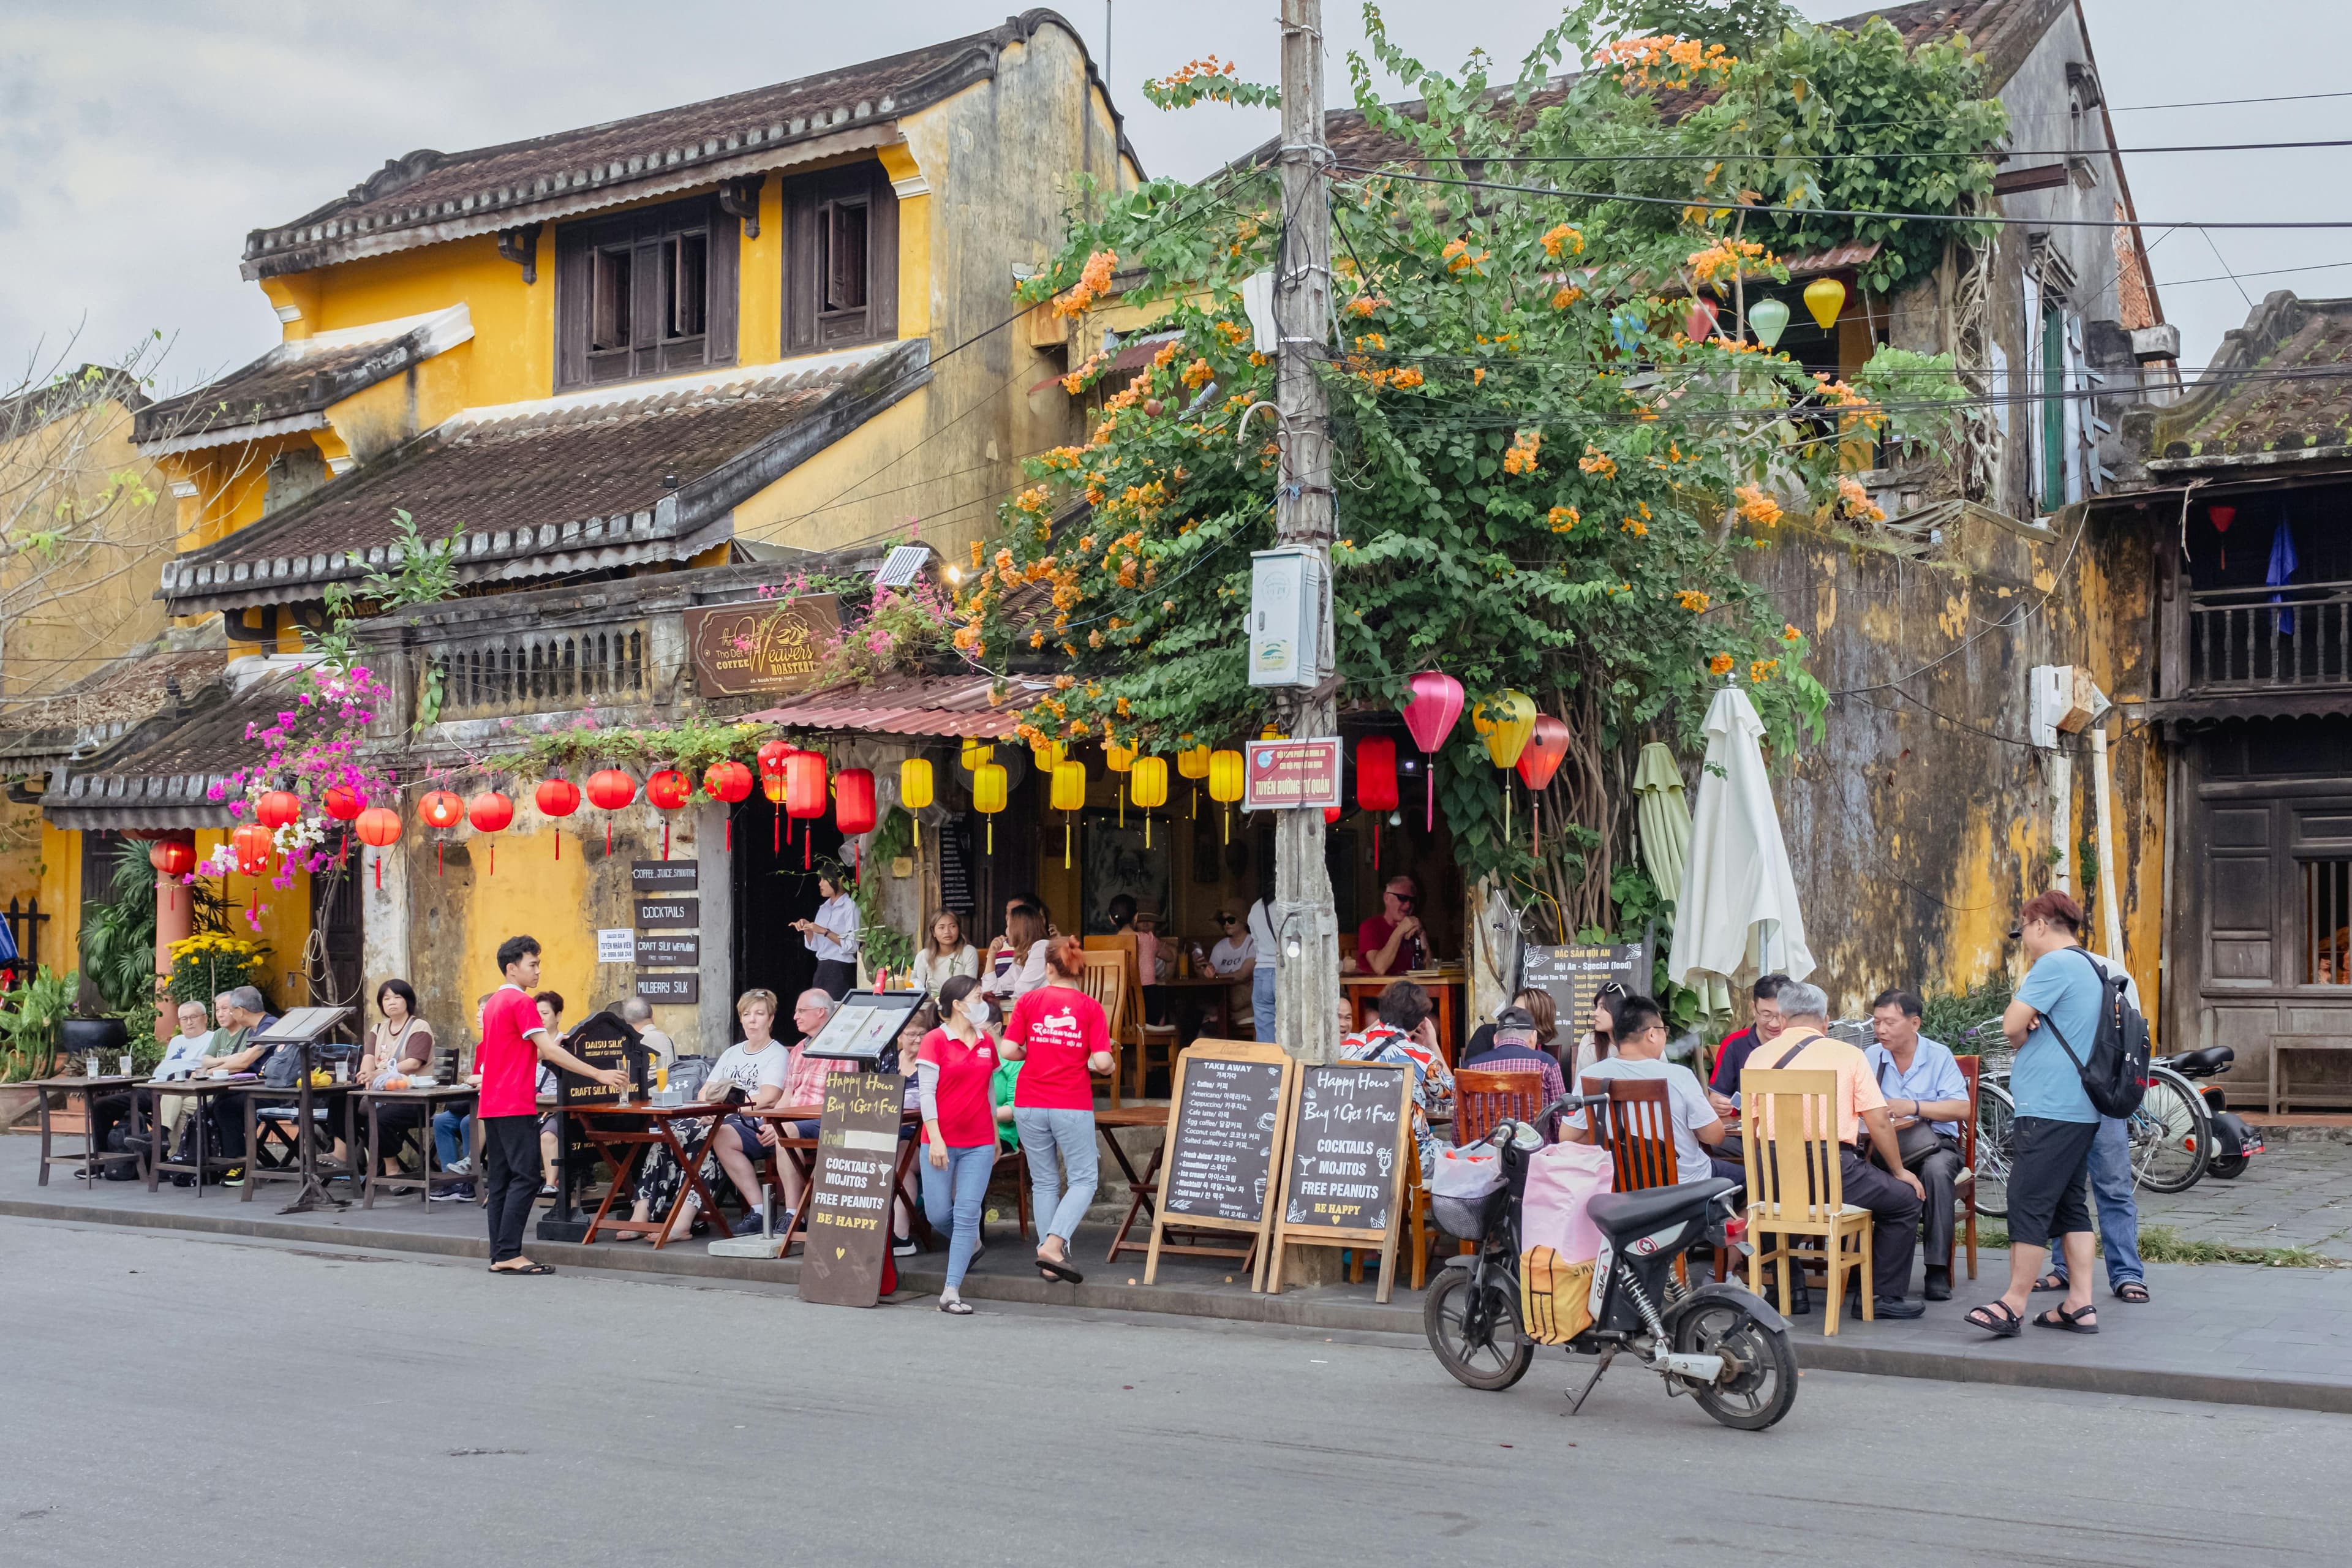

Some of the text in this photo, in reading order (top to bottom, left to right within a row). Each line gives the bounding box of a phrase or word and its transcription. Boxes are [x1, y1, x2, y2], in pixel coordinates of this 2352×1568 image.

[716, 658, 750, 670] COFFEE
[1256, 776, 1276, 796] TUYẾN
[1311, 774, 1330, 794] QUẢN
[643, 907, 685, 918] COCKTAILS
[638, 941, 657, 951] CRAFT
[1600, 949, 1610, 957] AN
[1554, 962, 1566, 972] Hội
[1583, 962, 1609, 972] Special
[638, 981, 688, 993] MULBERRY SILK
[1031, 1023, 1082, 1039] Restaurant
[585, 1041, 607, 1049] DAISU
[1227, 1064, 1253, 1072] AWAY
[570, 1086, 592, 1097] CRAFT
[593, 1085, 606, 1095] SILK
[826, 1072, 894, 1097] Happy Hour
[1317, 1071, 1390, 1100] Happy Hour
[827, 1096, 845, 1122] Buy
[1304, 1101, 1329, 1133] Buy
[1372, 1104, 1396, 1123] Free
[1317, 1139, 1374, 1155] COCKTAILS
[825, 1157, 876, 1174] COCKTAILS
[1319, 1160, 1366, 1176] MOJITOS
[825, 1172, 867, 1188] MOJITOS
[1301, 1181, 1379, 1199] FREE PEANUTS
[815, 1192, 884, 1210] FREE PEANUTS
[1314, 1202, 1361, 1215] BE HAPPY
[816, 1212, 878, 1230] BE HAPPY
